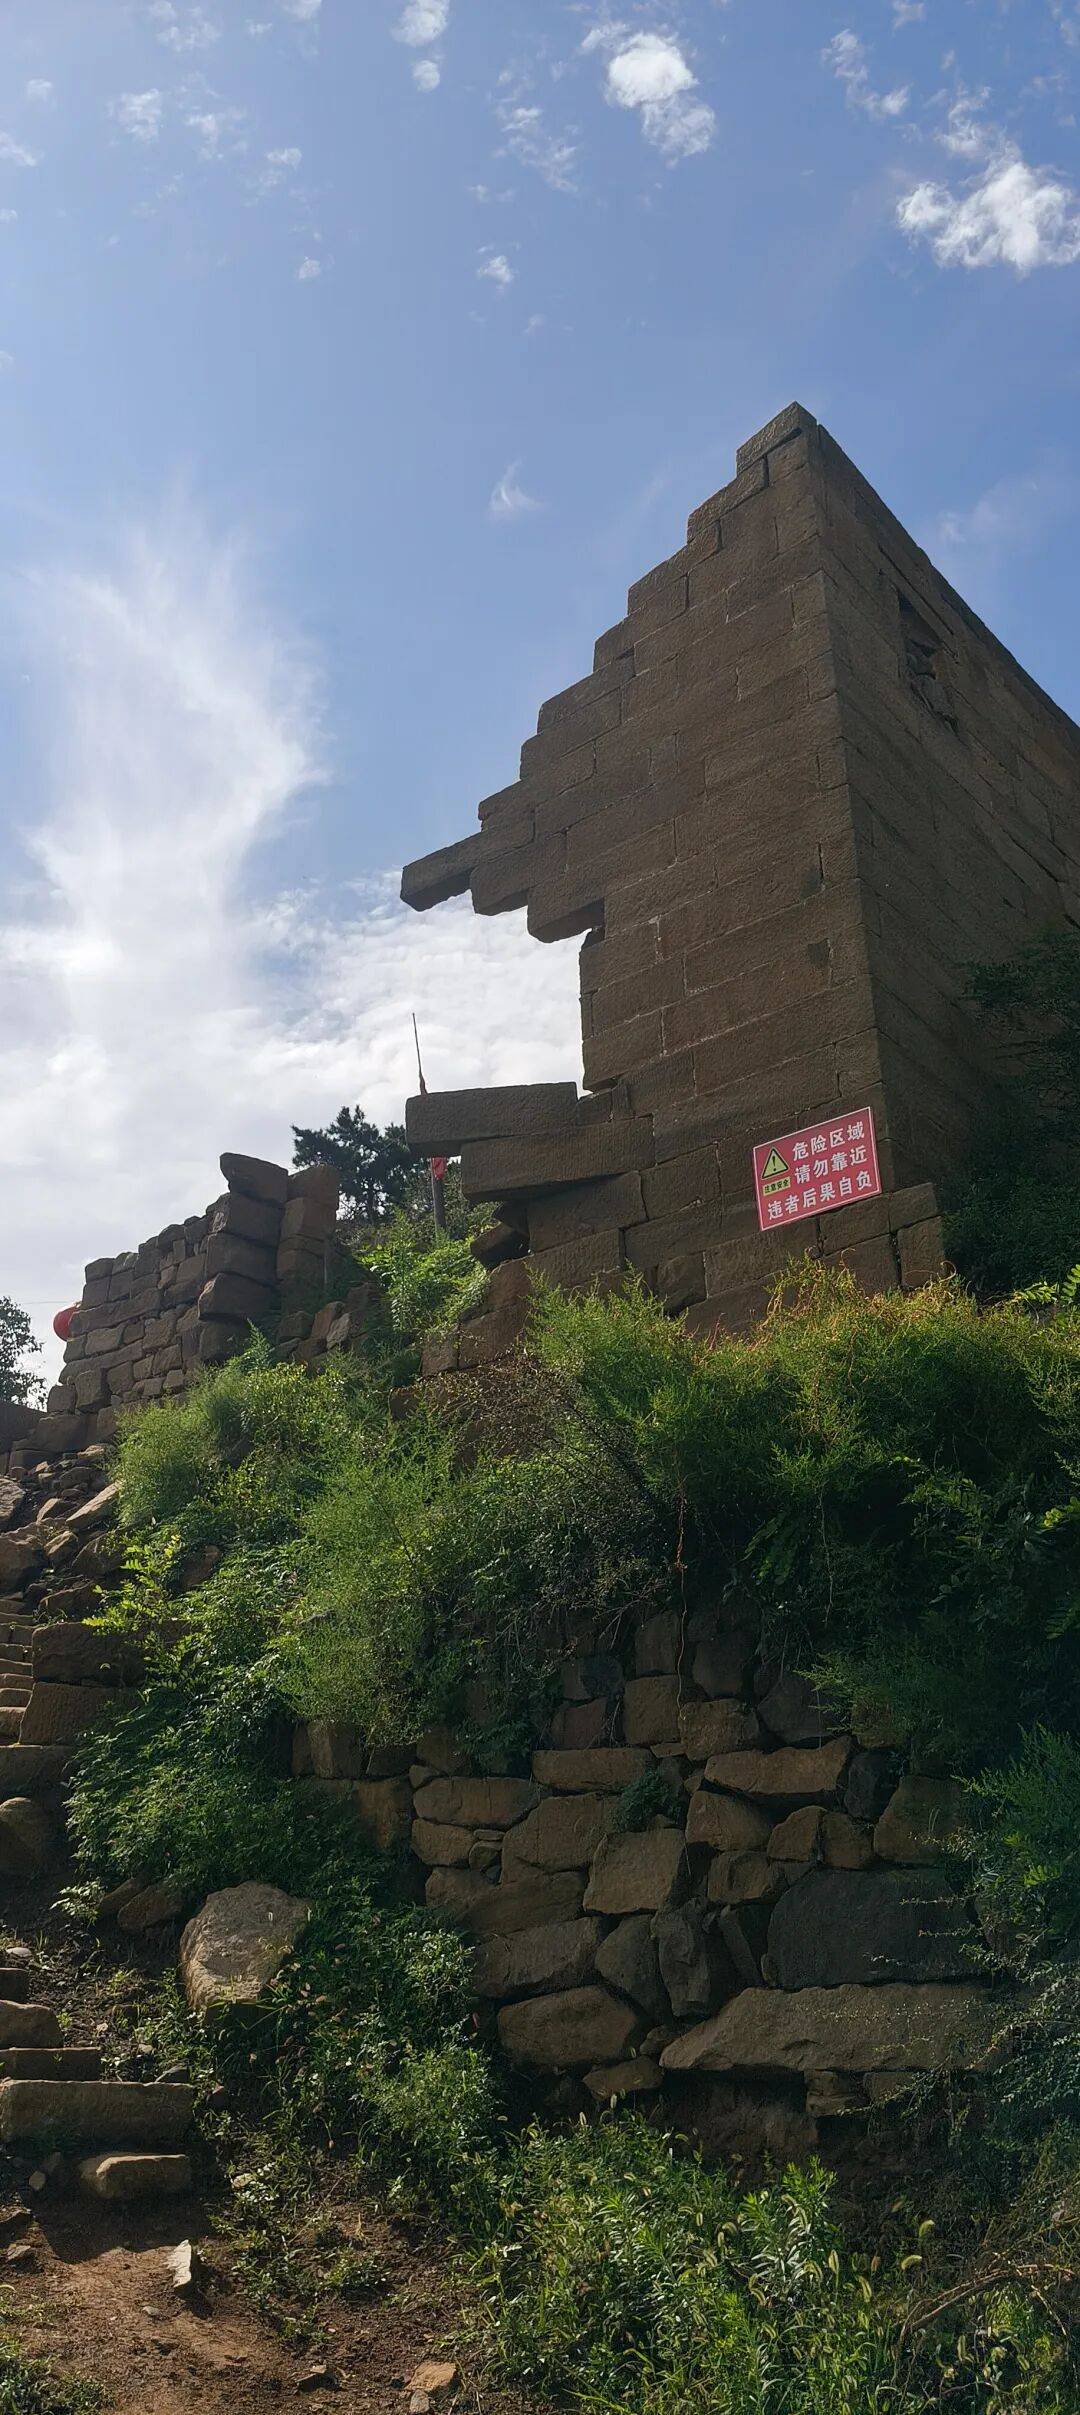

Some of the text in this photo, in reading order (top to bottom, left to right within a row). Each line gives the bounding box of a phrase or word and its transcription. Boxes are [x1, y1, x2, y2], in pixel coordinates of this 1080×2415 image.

[792, 1121, 865, 1161] 危险区域
[795, 1145, 868, 1184] 请勿靠近
[764, 1179, 789, 1193] 注意安全
[768, 1170, 872, 1220] 违者后果自负
